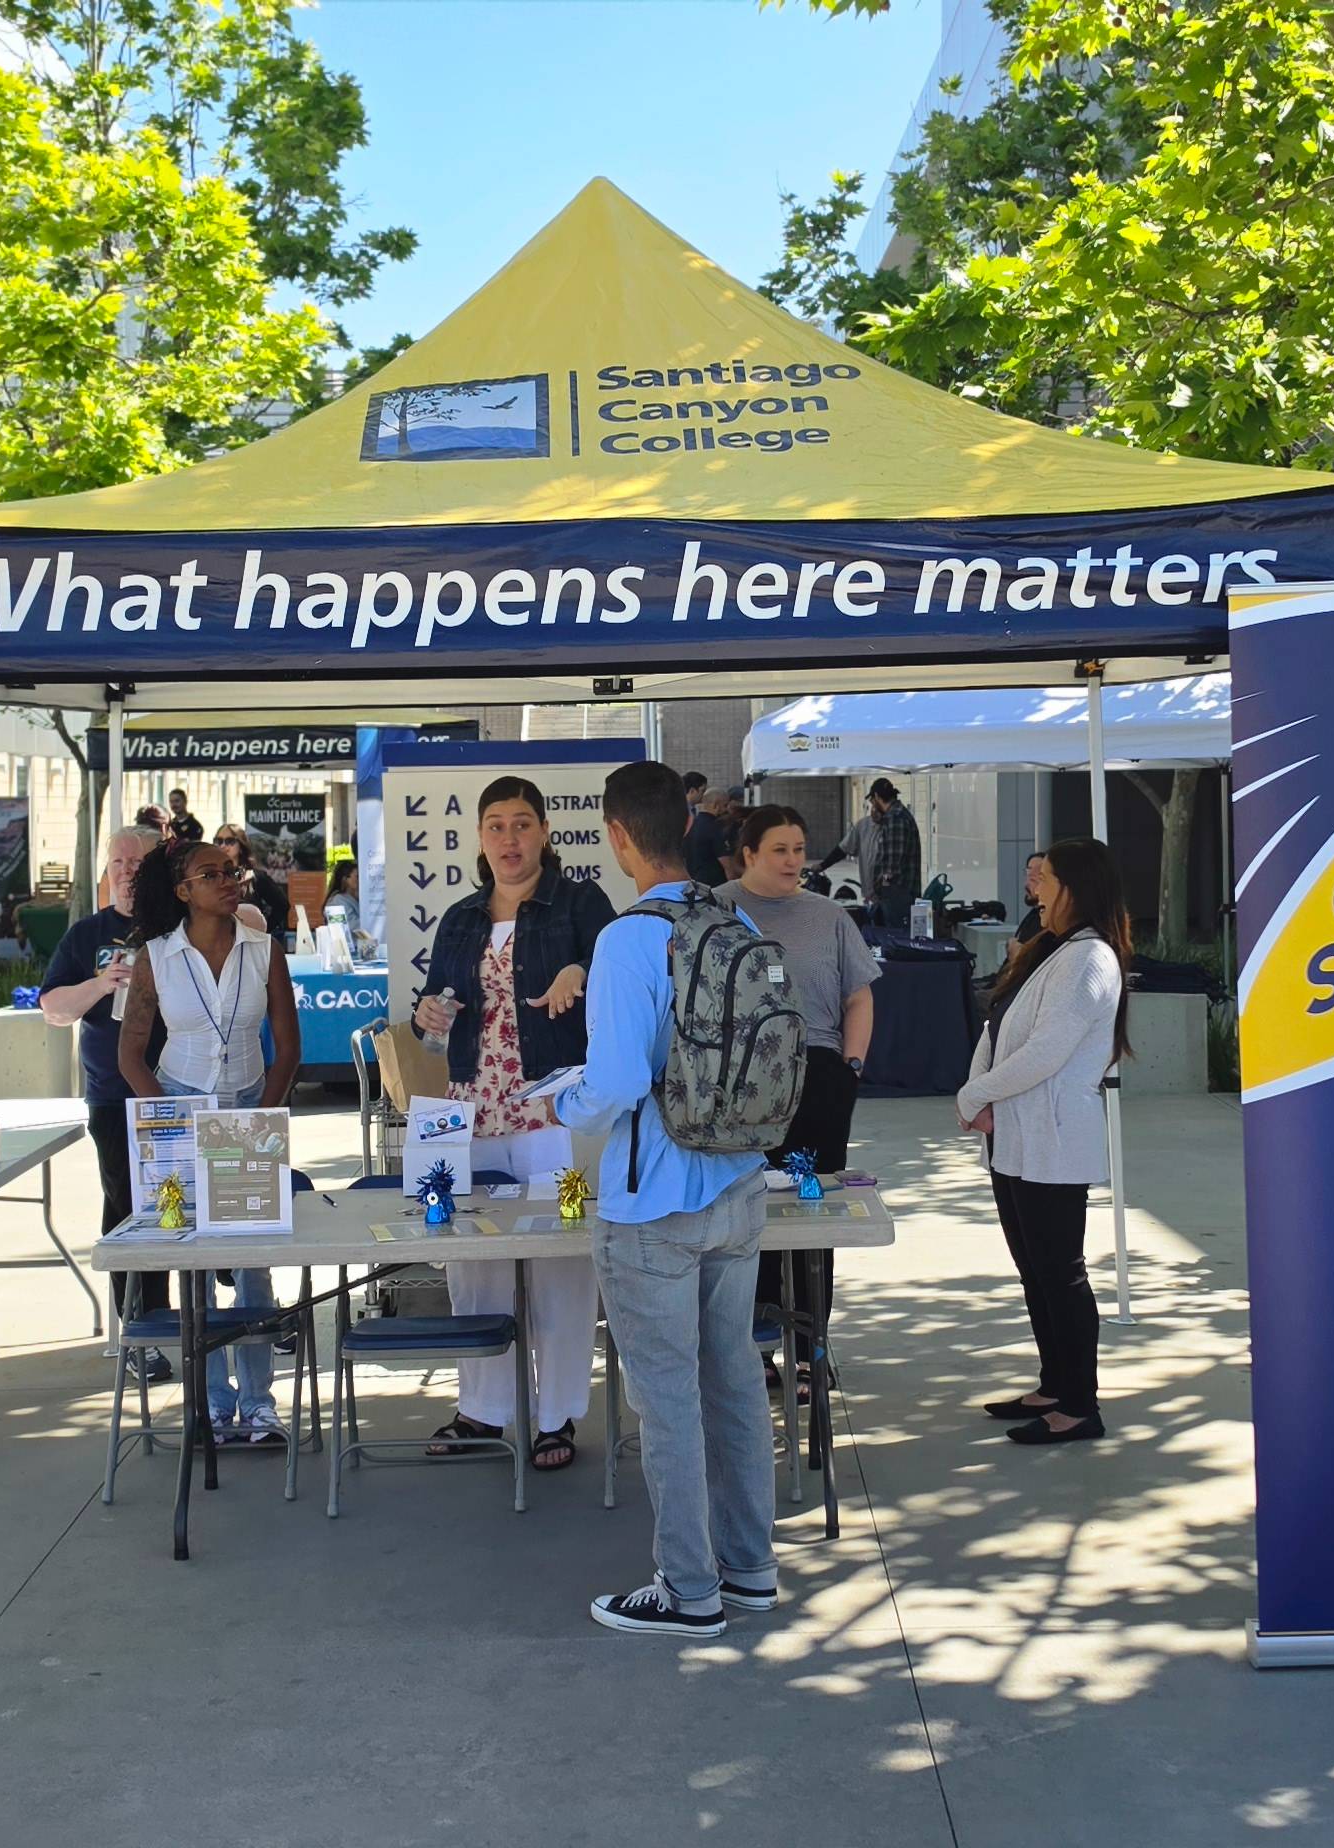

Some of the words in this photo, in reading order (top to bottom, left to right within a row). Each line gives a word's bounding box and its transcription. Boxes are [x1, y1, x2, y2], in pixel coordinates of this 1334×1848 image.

[597, 360, 860, 390] Santiago
[598, 395, 829, 423] Canyon
[600, 427, 830, 454] College
[234, 550, 645, 648] happens
[672, 542, 885, 620] here
[184, 735, 289, 760] happens
[297, 733, 352, 754] here
[249, 810, 321, 823] MAINTENANCE
[445, 794, 462, 815] A
[445, 830, 459, 851] B
[446, 865, 462, 886] D
